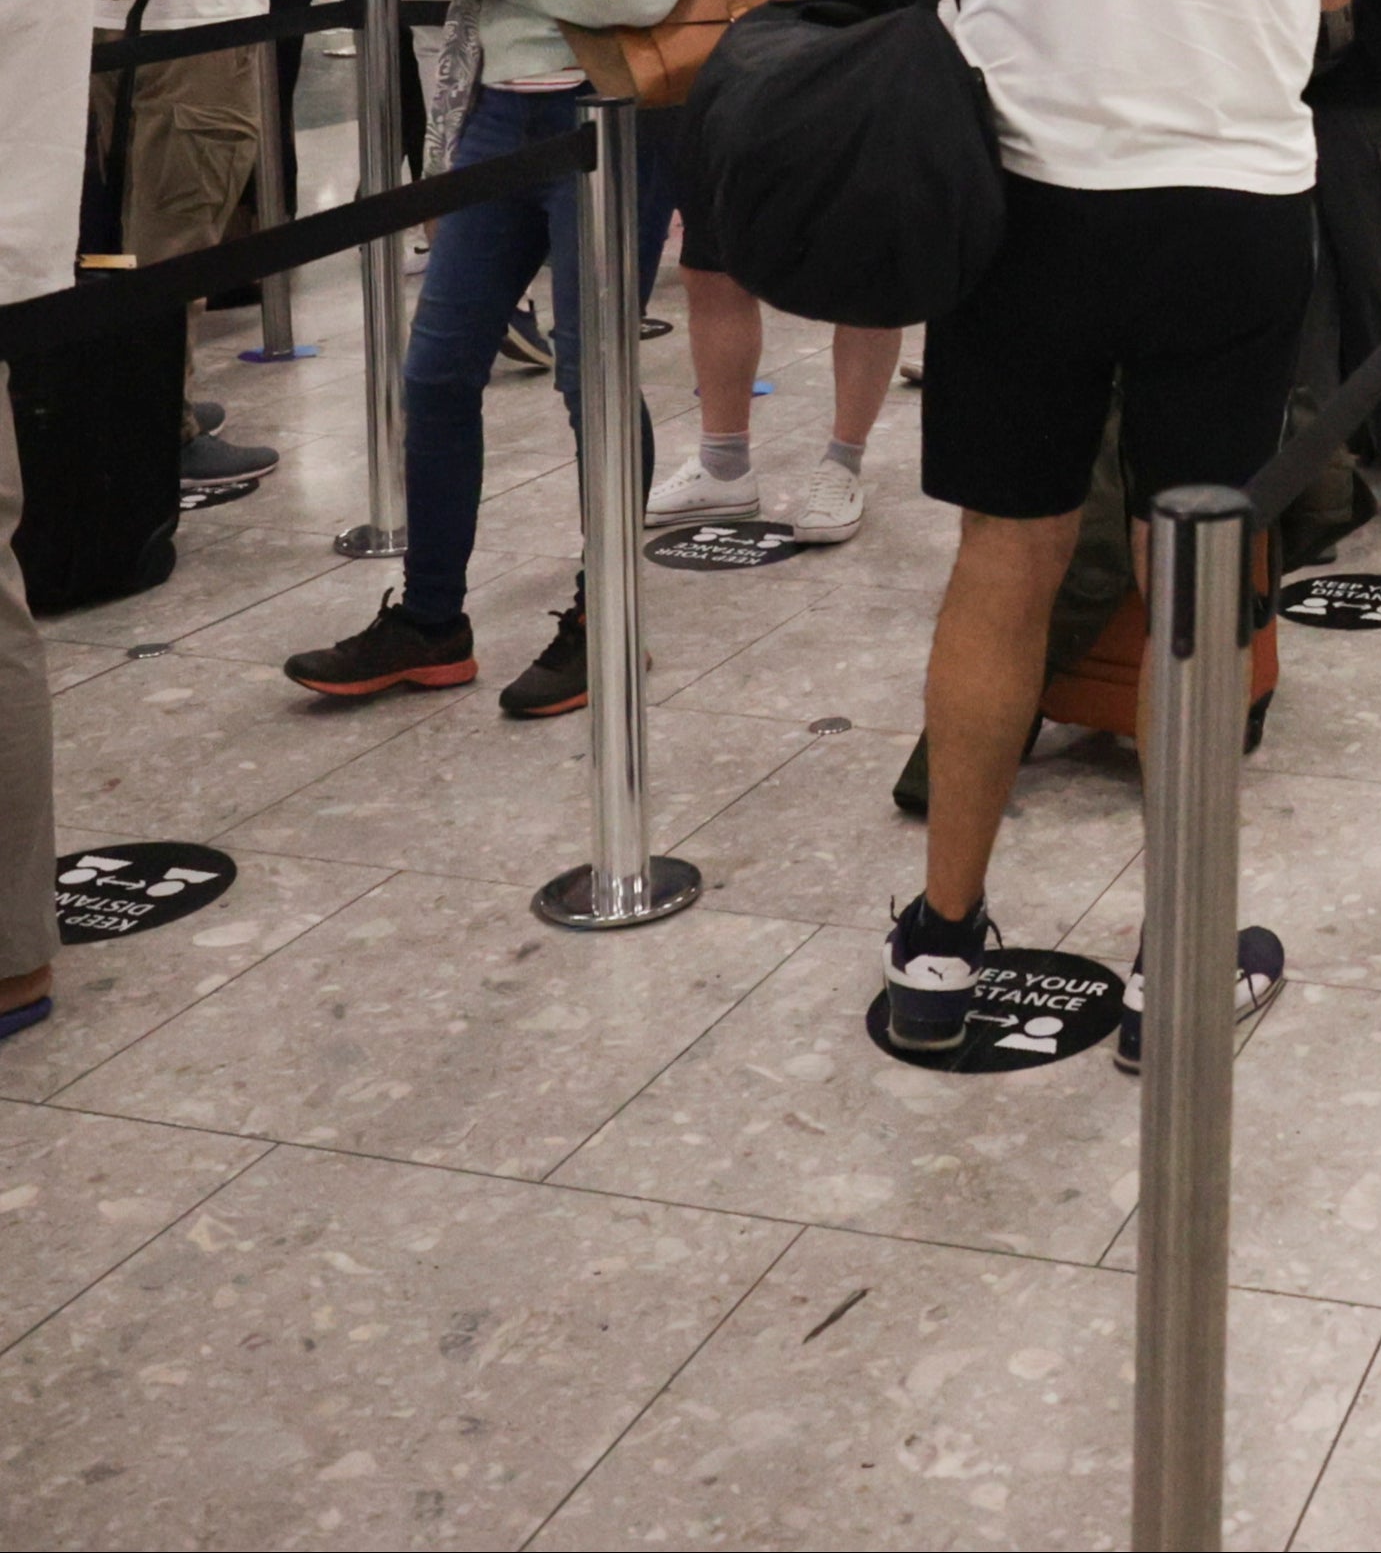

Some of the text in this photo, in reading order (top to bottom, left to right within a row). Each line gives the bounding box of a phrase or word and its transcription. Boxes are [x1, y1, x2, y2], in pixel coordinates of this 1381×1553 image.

[1311, 579, 1363, 590] KEEP
[55, 891, 155, 916] DISTAN
[64, 912, 139, 932] KEEP
[979, 967, 1109, 997] EP YOUR
[972, 984, 1087, 1011] STANCE
